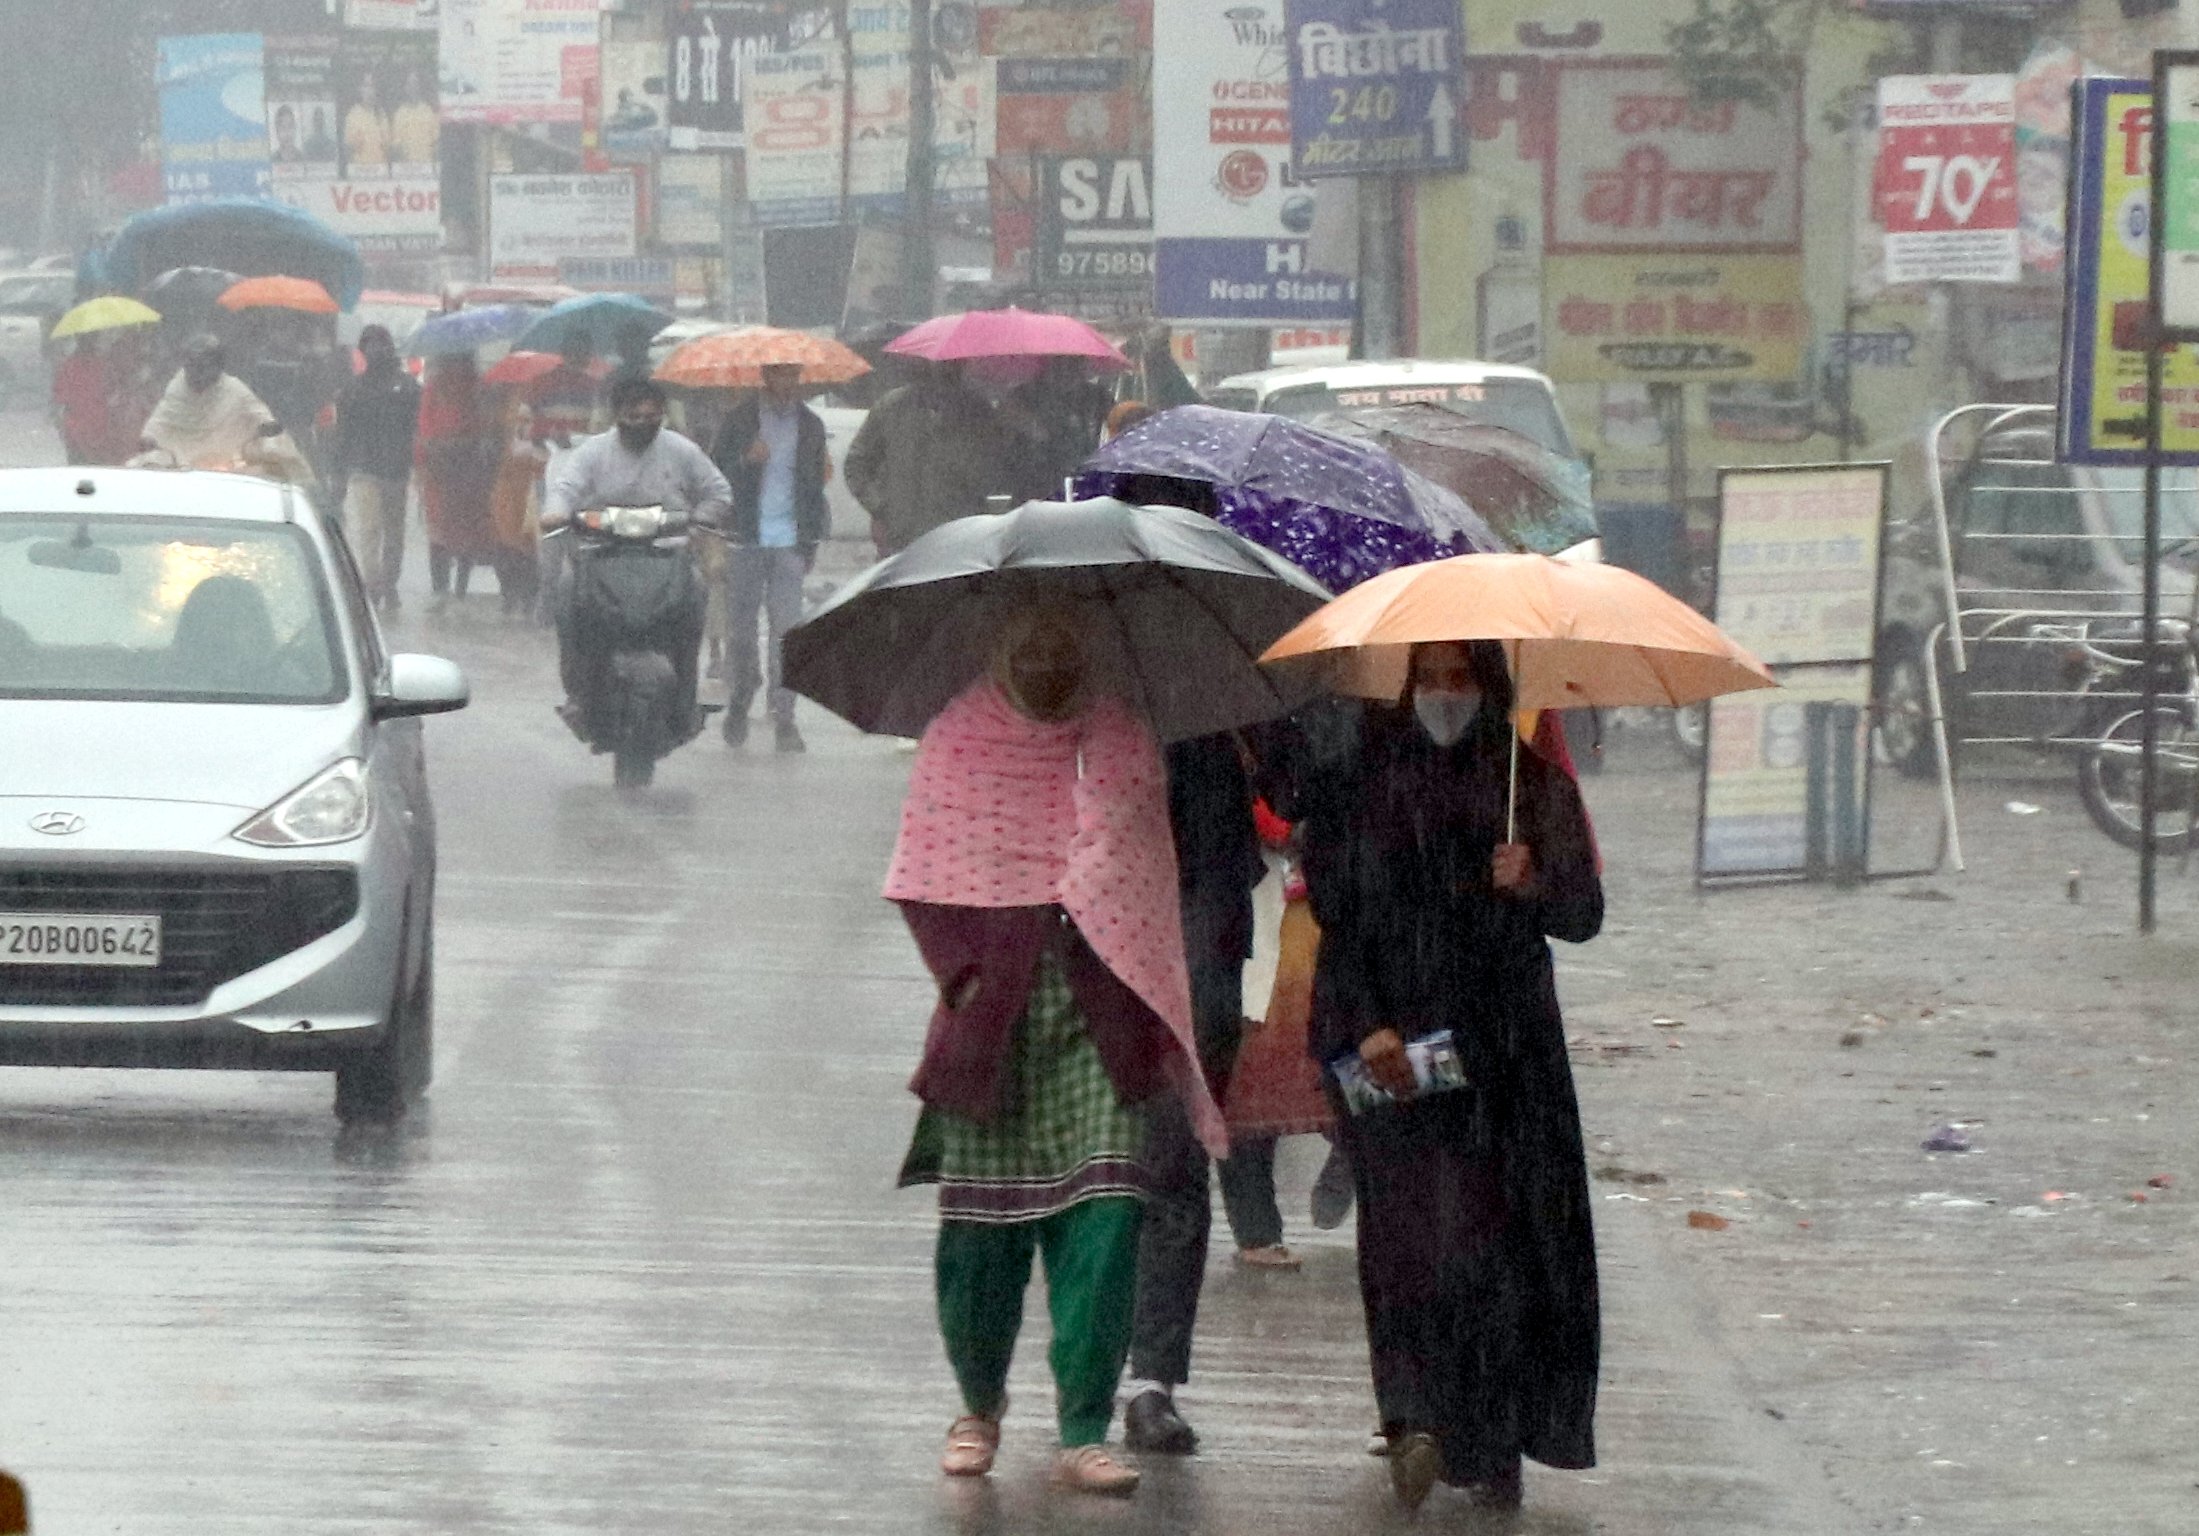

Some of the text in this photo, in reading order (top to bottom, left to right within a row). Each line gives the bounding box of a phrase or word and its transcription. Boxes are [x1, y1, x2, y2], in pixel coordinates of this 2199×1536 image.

[1328, 85, 1400, 124] 240
[1885, 102, 2012, 119] REDTAPE
[1213, 117, 1290, 132] HITA
[330, 185, 439, 213] Vector
[1059, 158, 1152, 221] SA
[1265, 243, 1309, 273] H
[1210, 279, 1268, 300] Near
[1275, 279, 1341, 300] State
